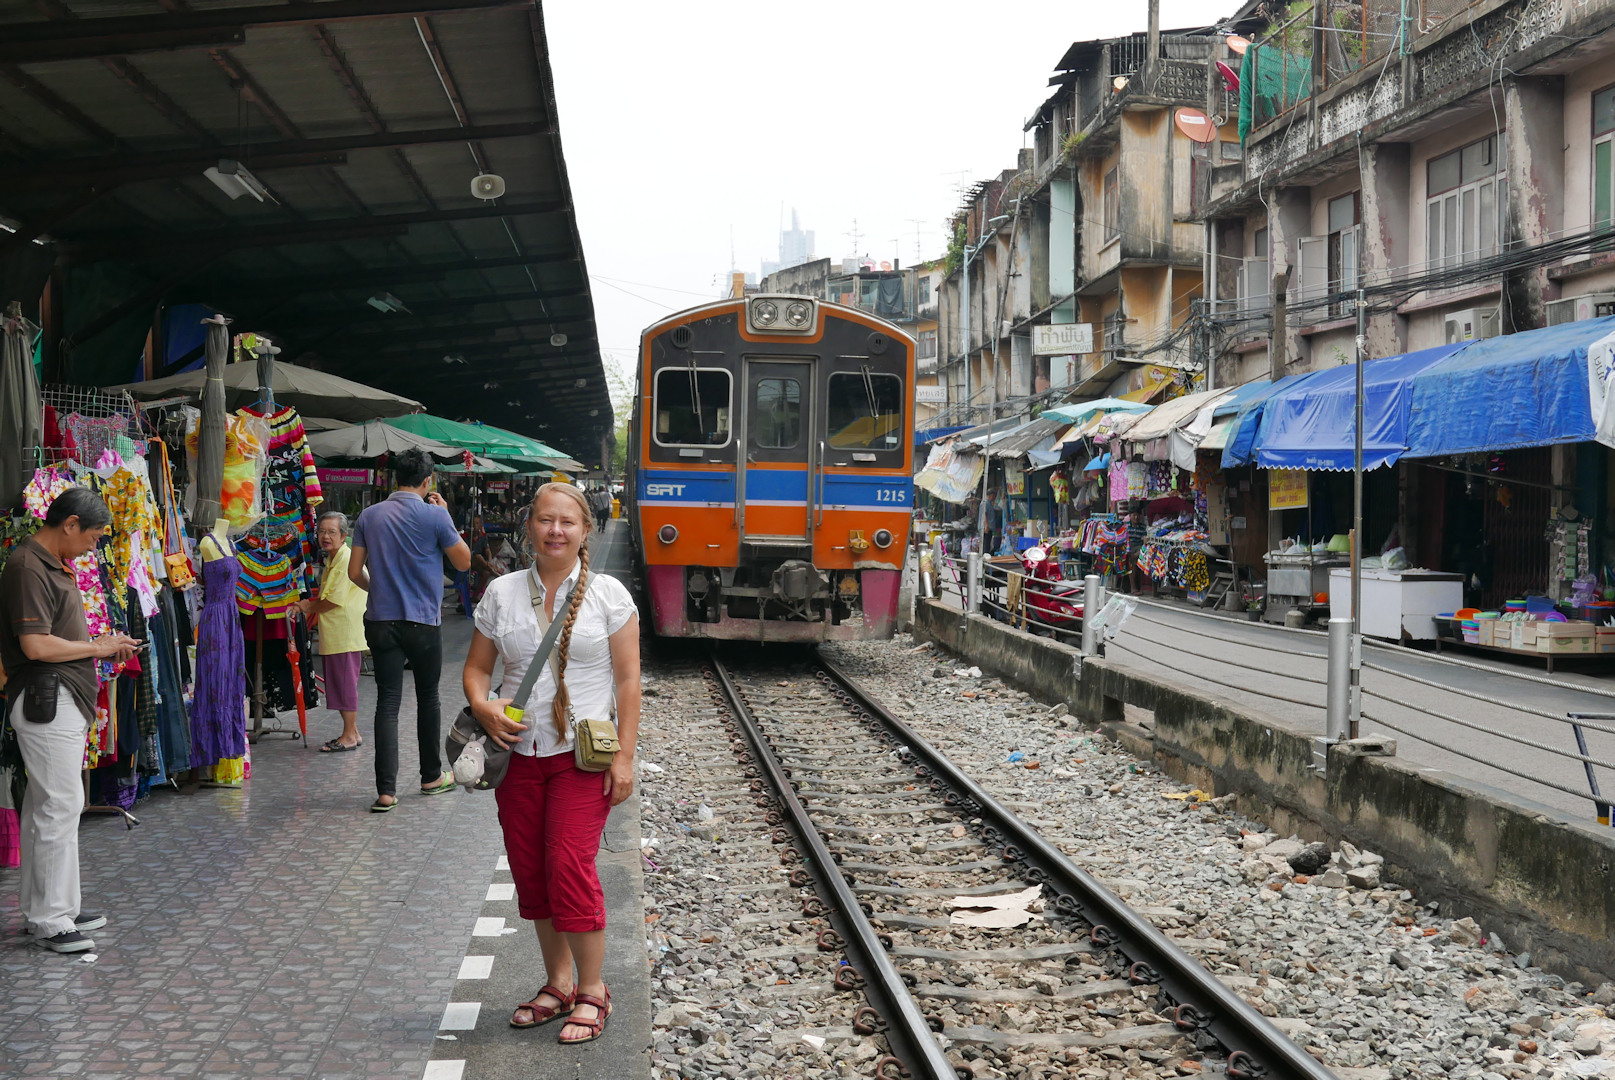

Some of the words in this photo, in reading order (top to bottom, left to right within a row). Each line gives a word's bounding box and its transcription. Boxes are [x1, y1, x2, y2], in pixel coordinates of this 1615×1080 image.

[1041, 326, 1085, 344] ทำฟัน
[646, 483, 686, 497] SRT
[876, 489, 905, 502] 1215
